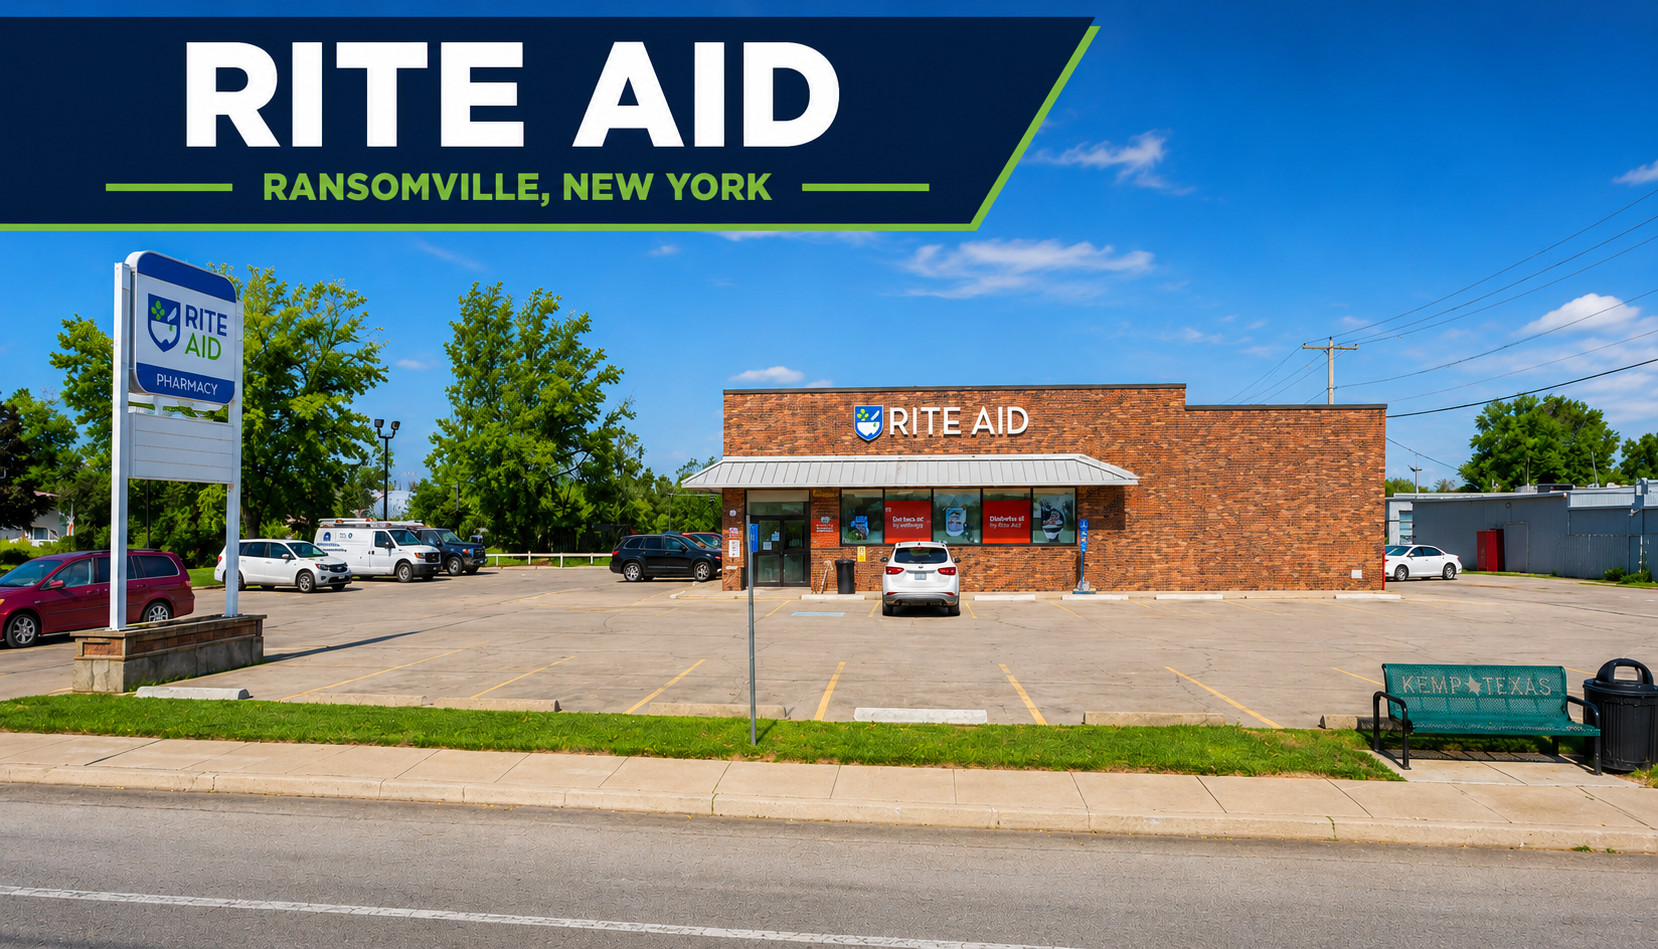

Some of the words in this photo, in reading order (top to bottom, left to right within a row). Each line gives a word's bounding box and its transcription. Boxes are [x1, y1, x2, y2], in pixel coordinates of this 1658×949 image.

[185, 304, 228, 337] RITE
[184, 332, 222, 361] AID
[156, 373, 218, 396] PHARMACY
[889, 406, 963, 436] RITE
[971, 405, 1030, 436] AID
[1402, 675, 1462, 694] KEMP
[1482, 676, 1552, 696] TEXAS
